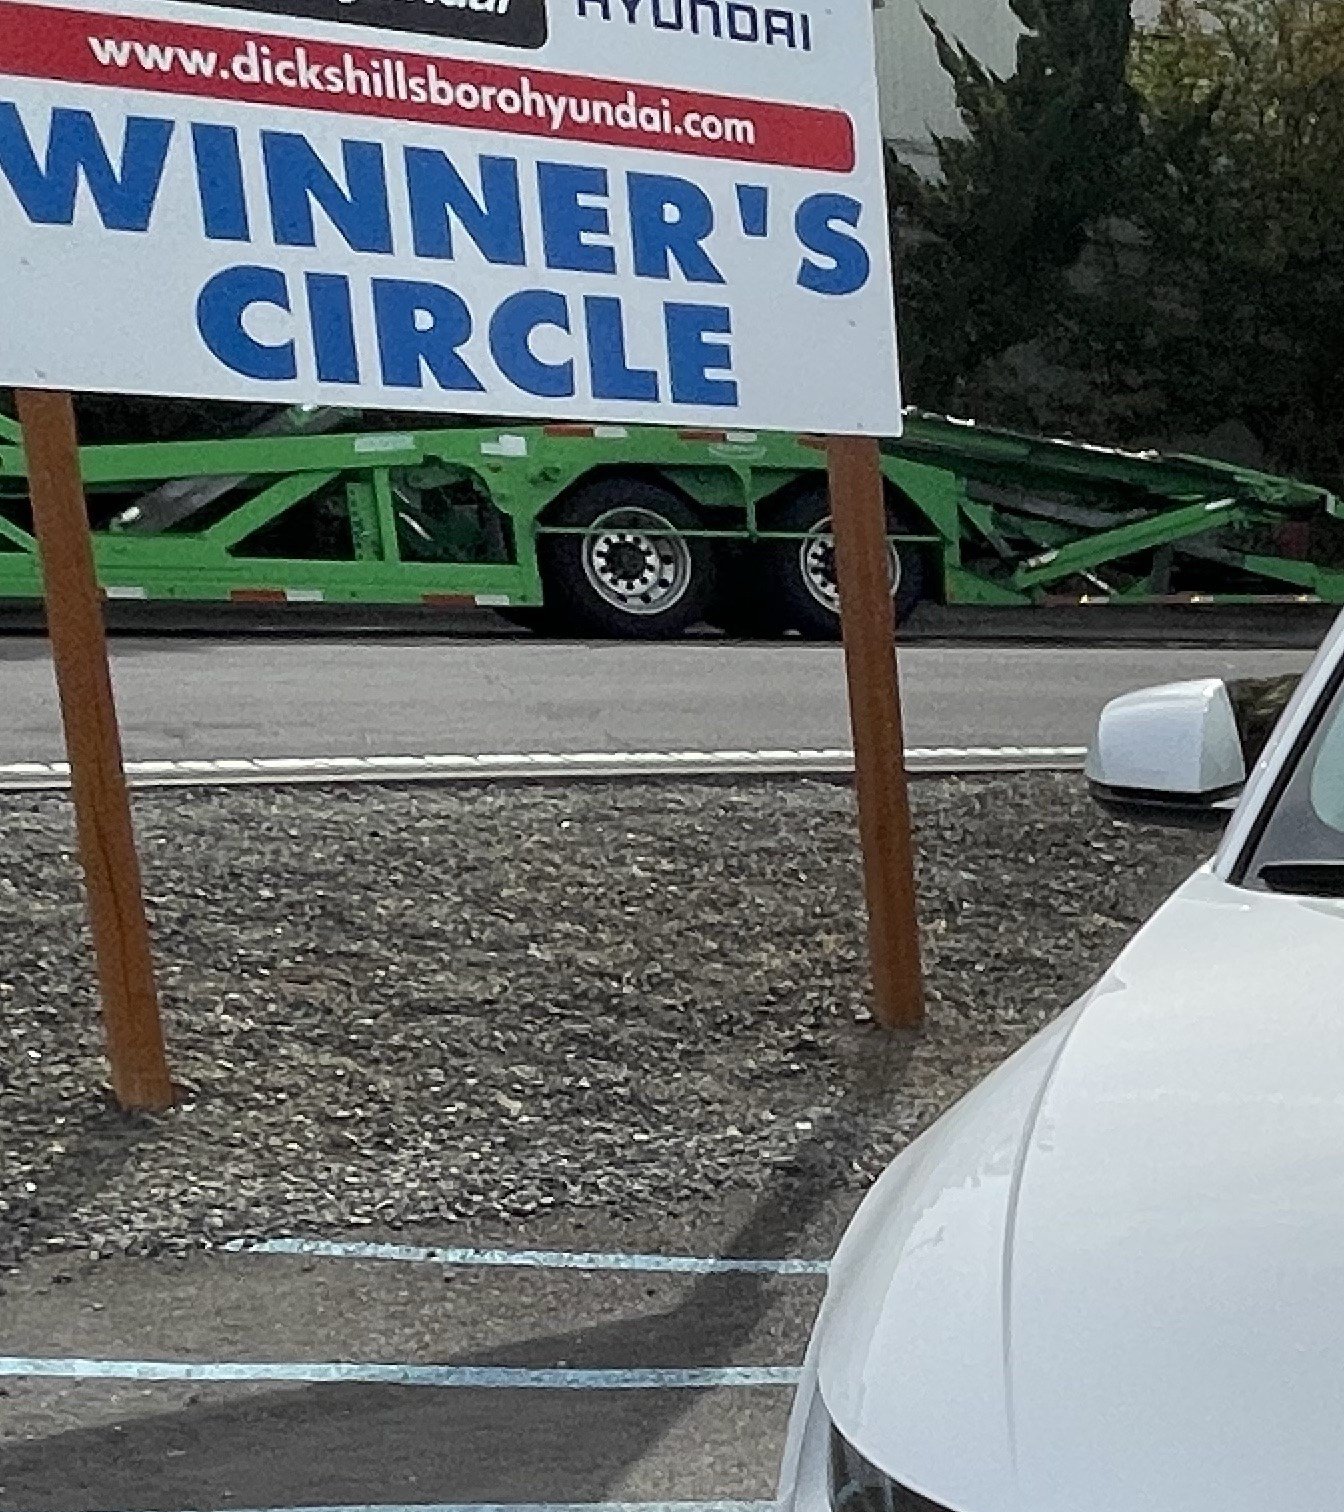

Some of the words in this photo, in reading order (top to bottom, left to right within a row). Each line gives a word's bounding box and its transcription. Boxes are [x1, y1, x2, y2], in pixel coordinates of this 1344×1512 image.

[87, 35, 757, 145] www.dickshillsborohyundai.com
[0, 99, 871, 297] WINNER'S
[196, 263, 739, 408] CIRCLE
